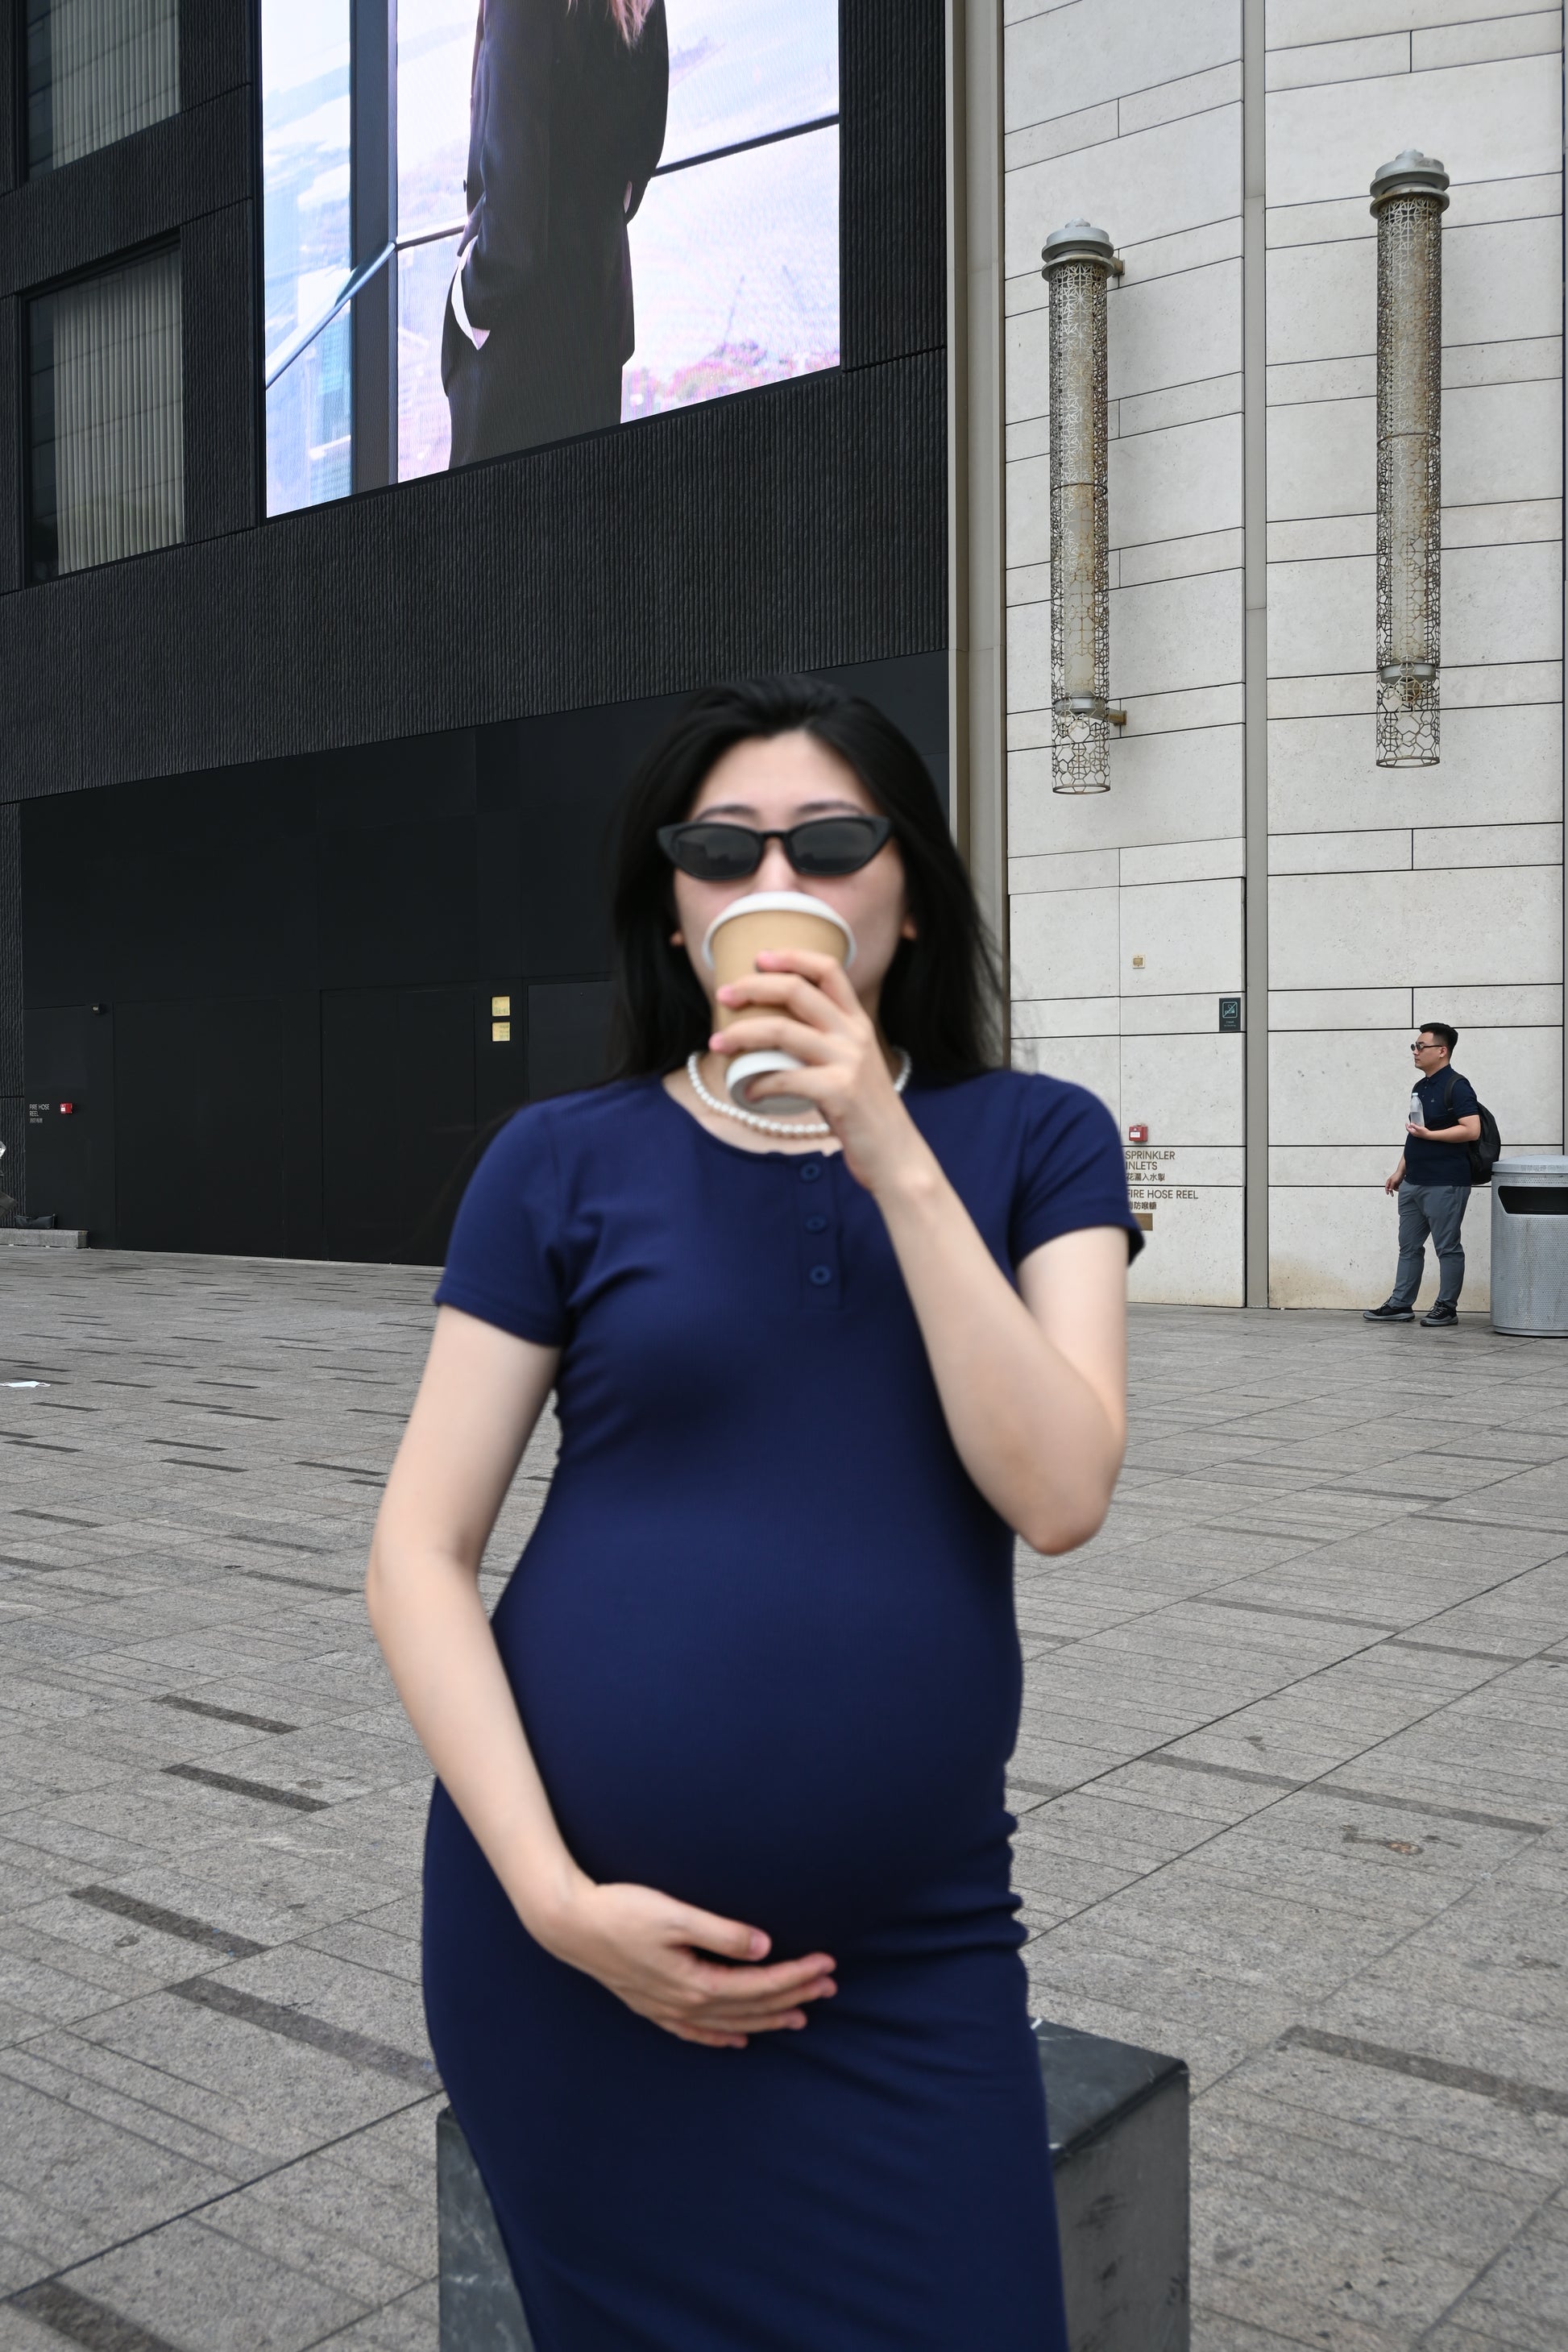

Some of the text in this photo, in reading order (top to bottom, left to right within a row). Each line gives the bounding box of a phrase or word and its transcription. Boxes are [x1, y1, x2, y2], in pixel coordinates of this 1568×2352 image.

[1125, 1151, 1176, 1159] SPRINKLER
[1126, 1161, 1158, 1170] INLETS
[1147, 1189, 1173, 1199] HOSE
[1176, 1190, 1199, 1199] REEL
